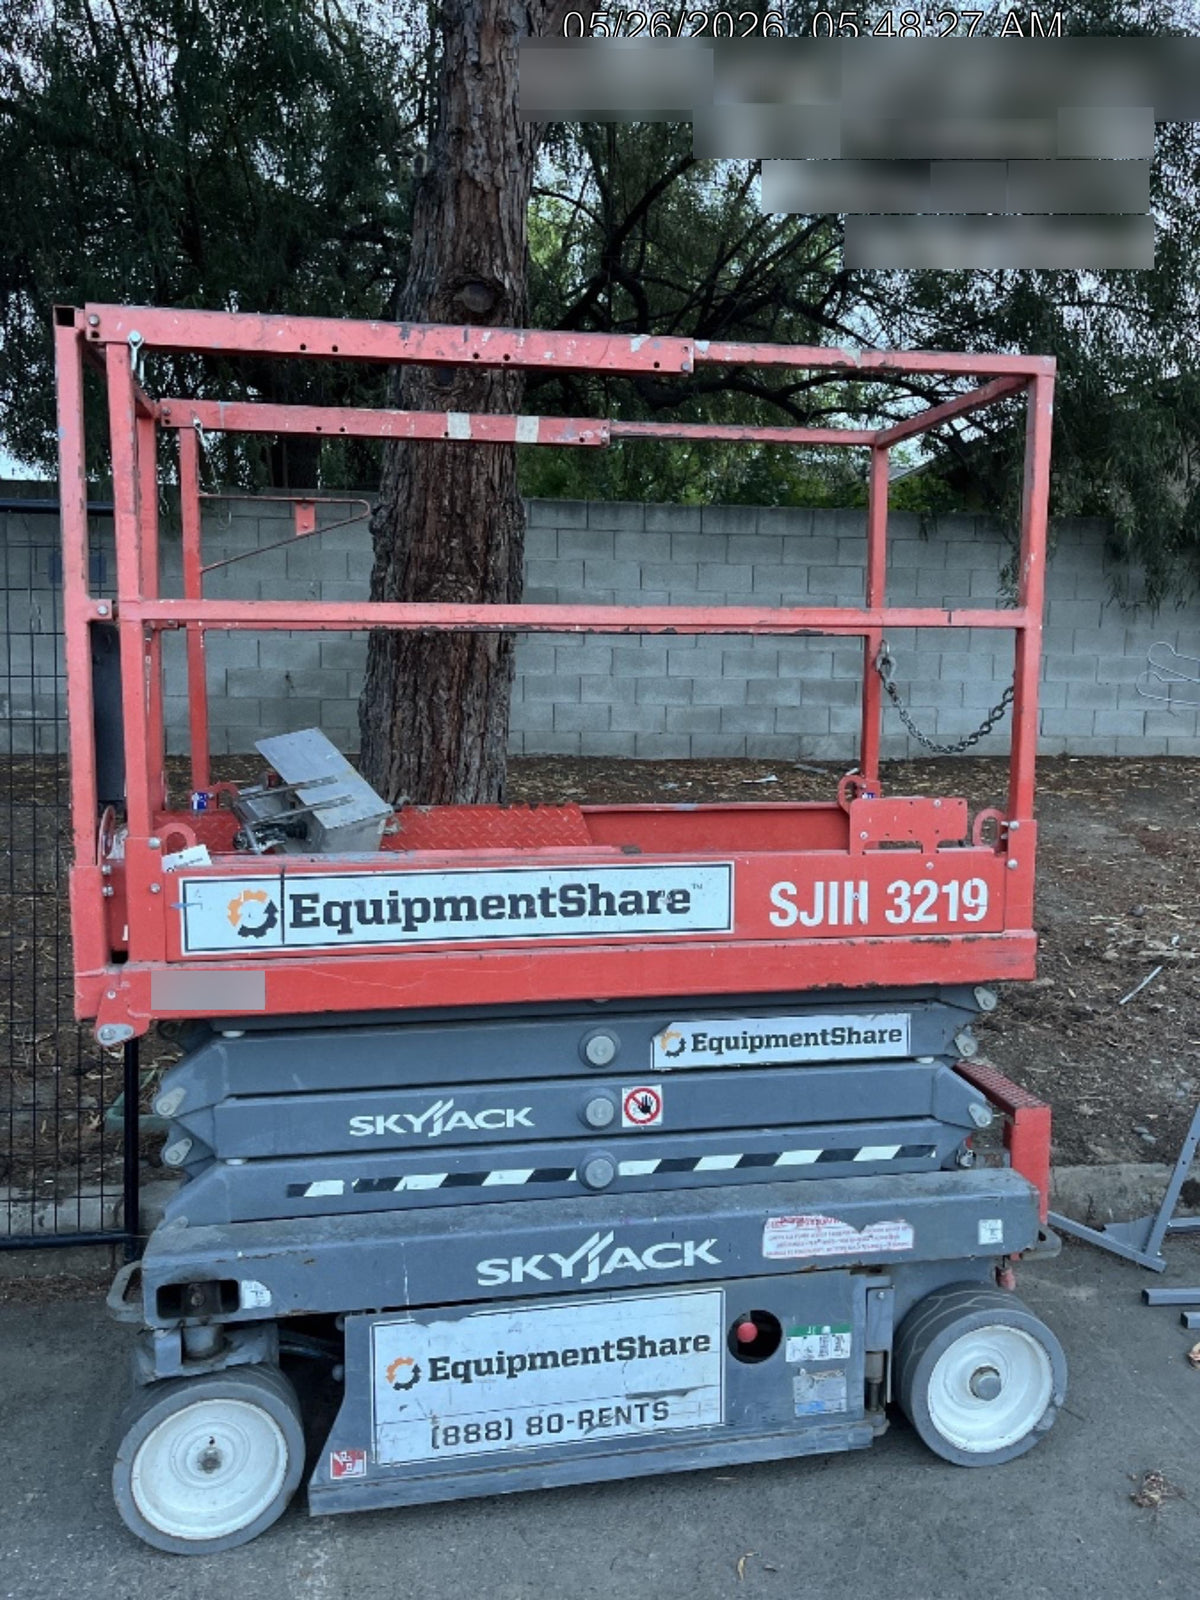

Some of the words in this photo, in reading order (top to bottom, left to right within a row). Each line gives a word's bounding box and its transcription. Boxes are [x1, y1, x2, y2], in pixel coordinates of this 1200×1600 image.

[289, 882, 691, 934] EquipmentShare
[885, 878, 989, 924] 3219
[690, 1026, 903, 1054] EquipmentShare
[349, 1099, 536, 1137] SKYJACK
[476, 1231, 722, 1285] SKYJACK
[428, 1333, 711, 1383] EquipmentShare
[431, 1417, 513, 1449] (888)
[525, 1401, 671, 1436] 80-RENTS
